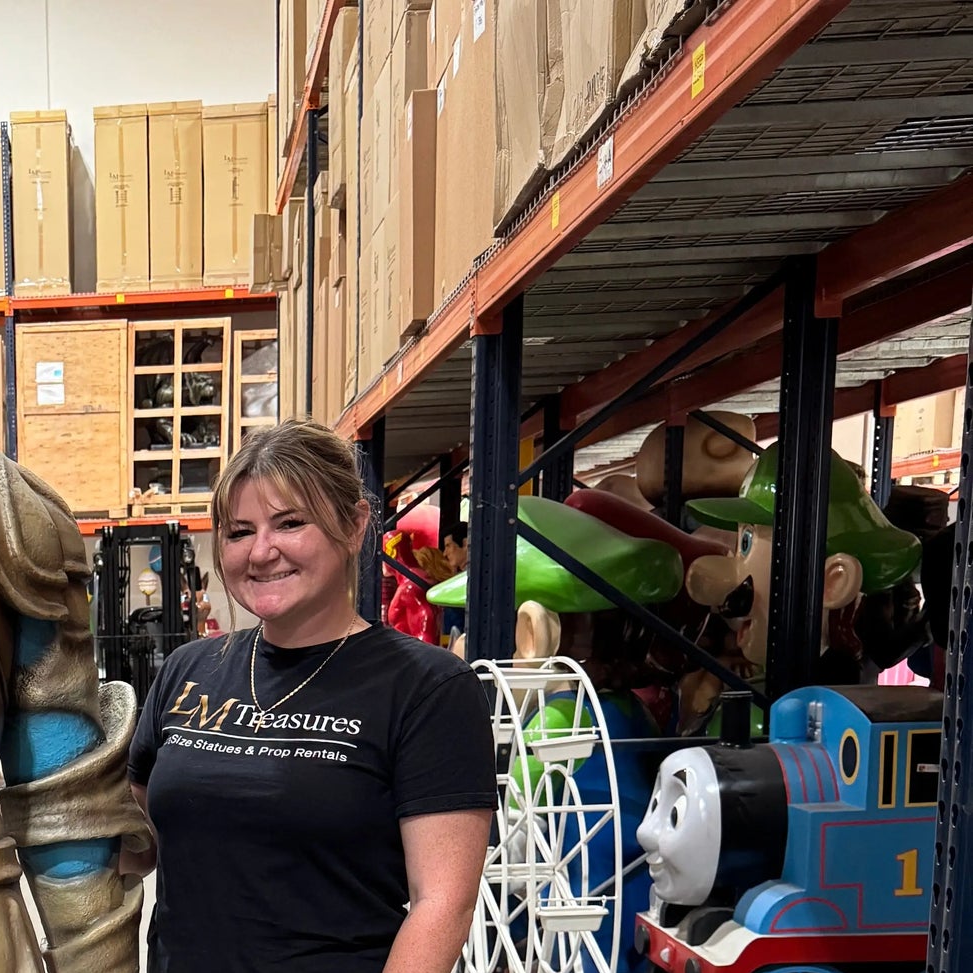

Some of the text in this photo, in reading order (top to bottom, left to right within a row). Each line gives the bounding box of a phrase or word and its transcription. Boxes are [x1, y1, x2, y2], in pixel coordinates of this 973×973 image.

[168, 681, 362, 735] LM Treasures
[193, 738, 243, 755] Statues
[244, 745, 255, 756] &
[257, 746, 291, 759] Prop
[293, 748, 348, 762] Rentals
[893, 849, 923, 897] 1
